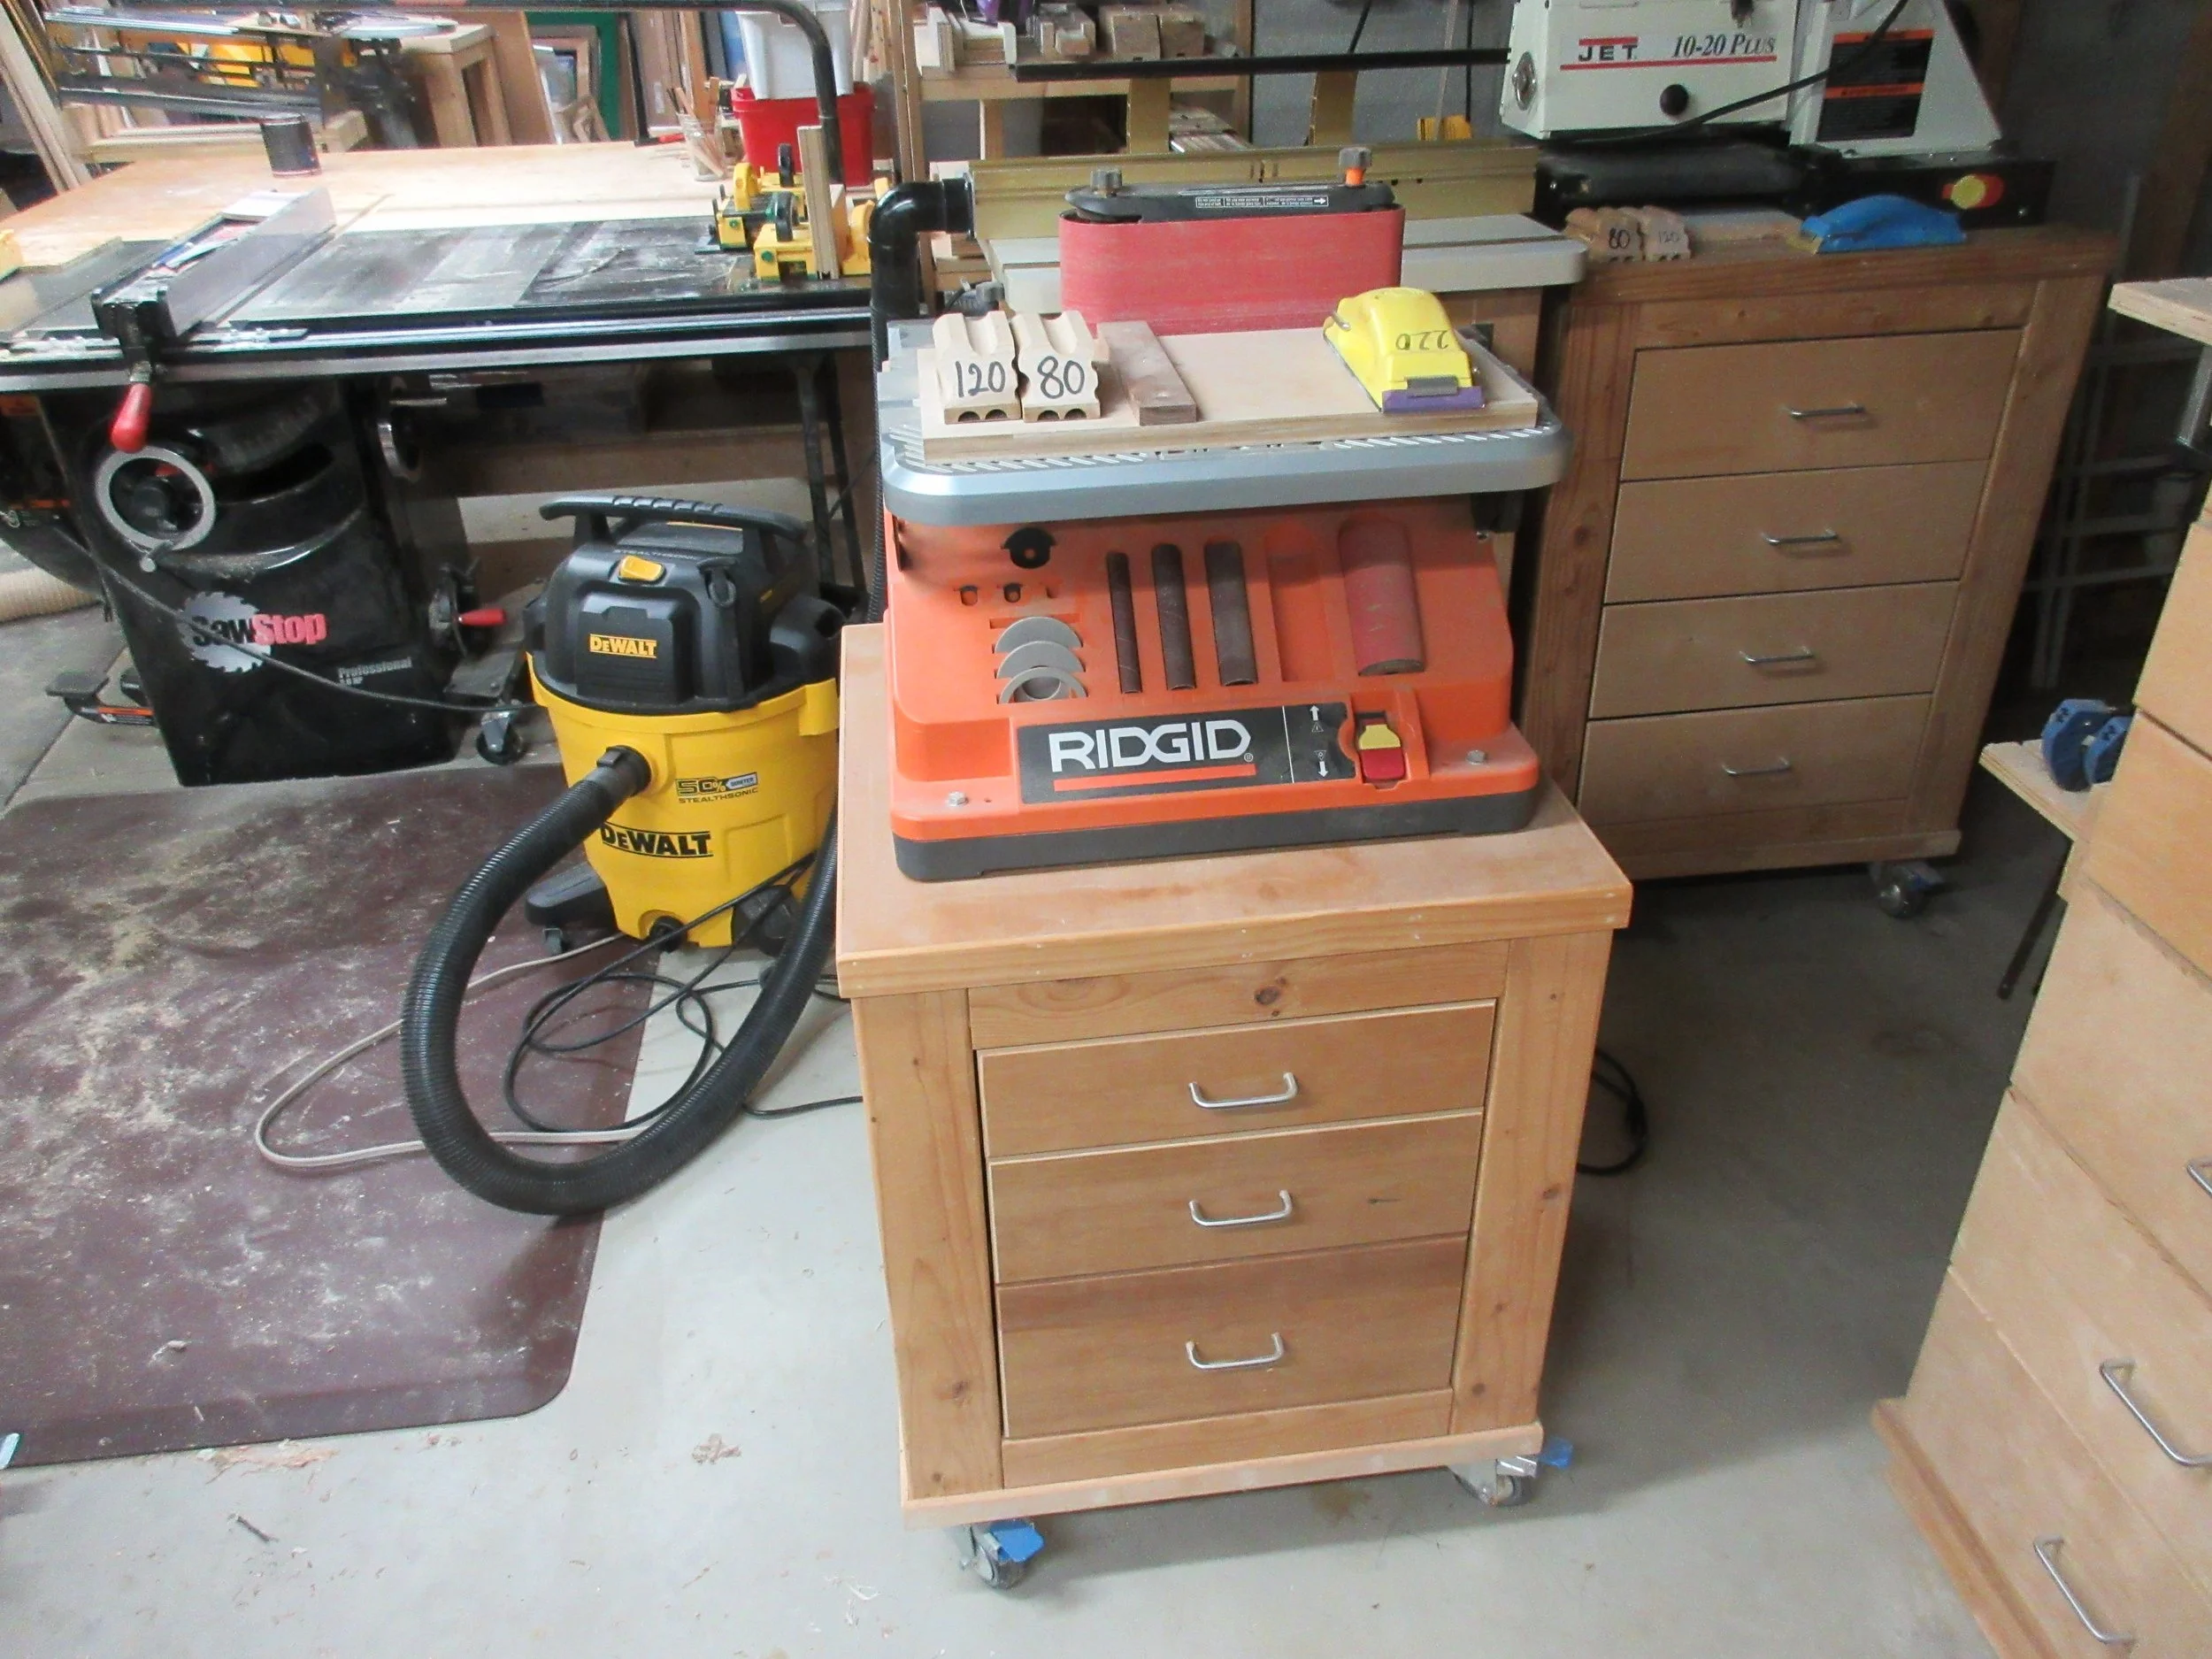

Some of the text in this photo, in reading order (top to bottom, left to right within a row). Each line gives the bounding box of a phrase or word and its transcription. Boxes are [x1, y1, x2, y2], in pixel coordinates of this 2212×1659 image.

[1578, 44, 1638, 62] JET
[1671, 34, 1725, 58] 10-20
[1609, 227, 1631, 249] 80
[955, 360, 1006, 398] 120
[1037, 355, 1085, 399] 80
[191, 613, 327, 647] SawStop
[1048, 719, 1252, 773] RIDGID
[676, 777, 726, 796] 50%
[679, 787, 758, 804] STEALTHSONIC
